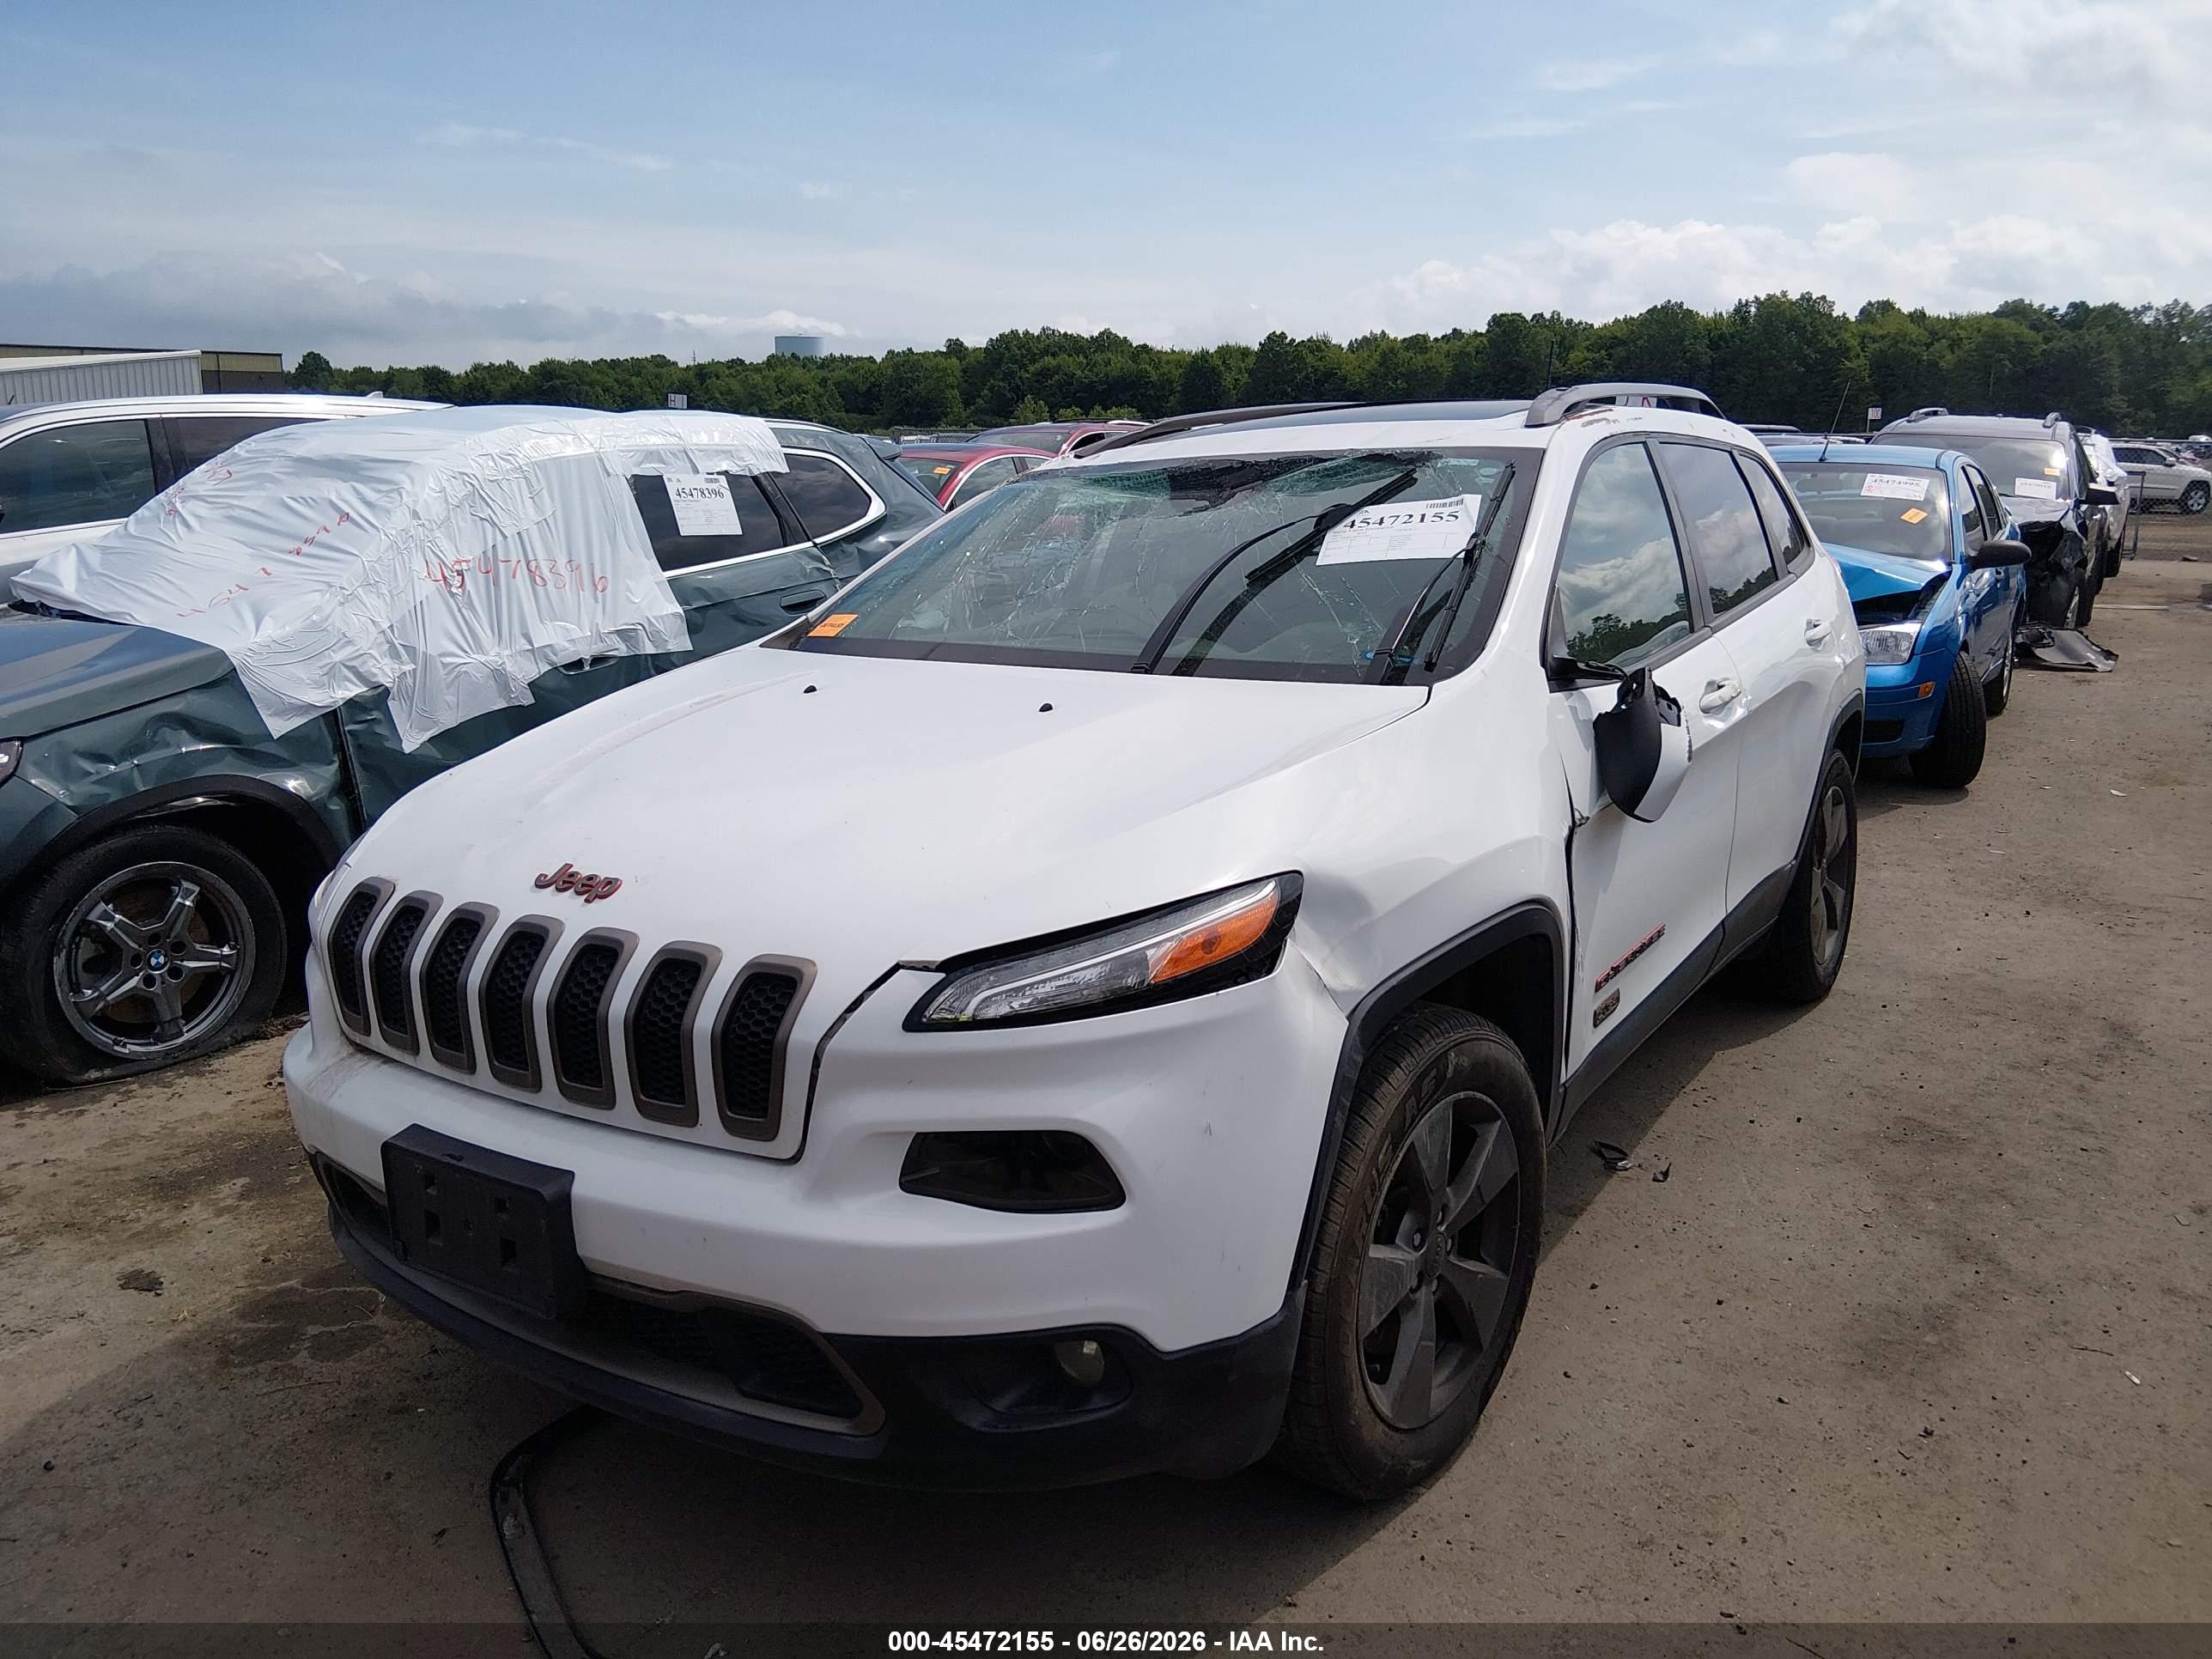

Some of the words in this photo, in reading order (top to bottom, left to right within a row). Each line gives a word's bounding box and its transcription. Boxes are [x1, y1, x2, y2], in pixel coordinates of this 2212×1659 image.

[675, 487, 725, 499] 45478396
[1343, 510, 1460, 529] 45472155
[425, 555, 609, 593] 45478396
[535, 863, 623, 903] Jeep
